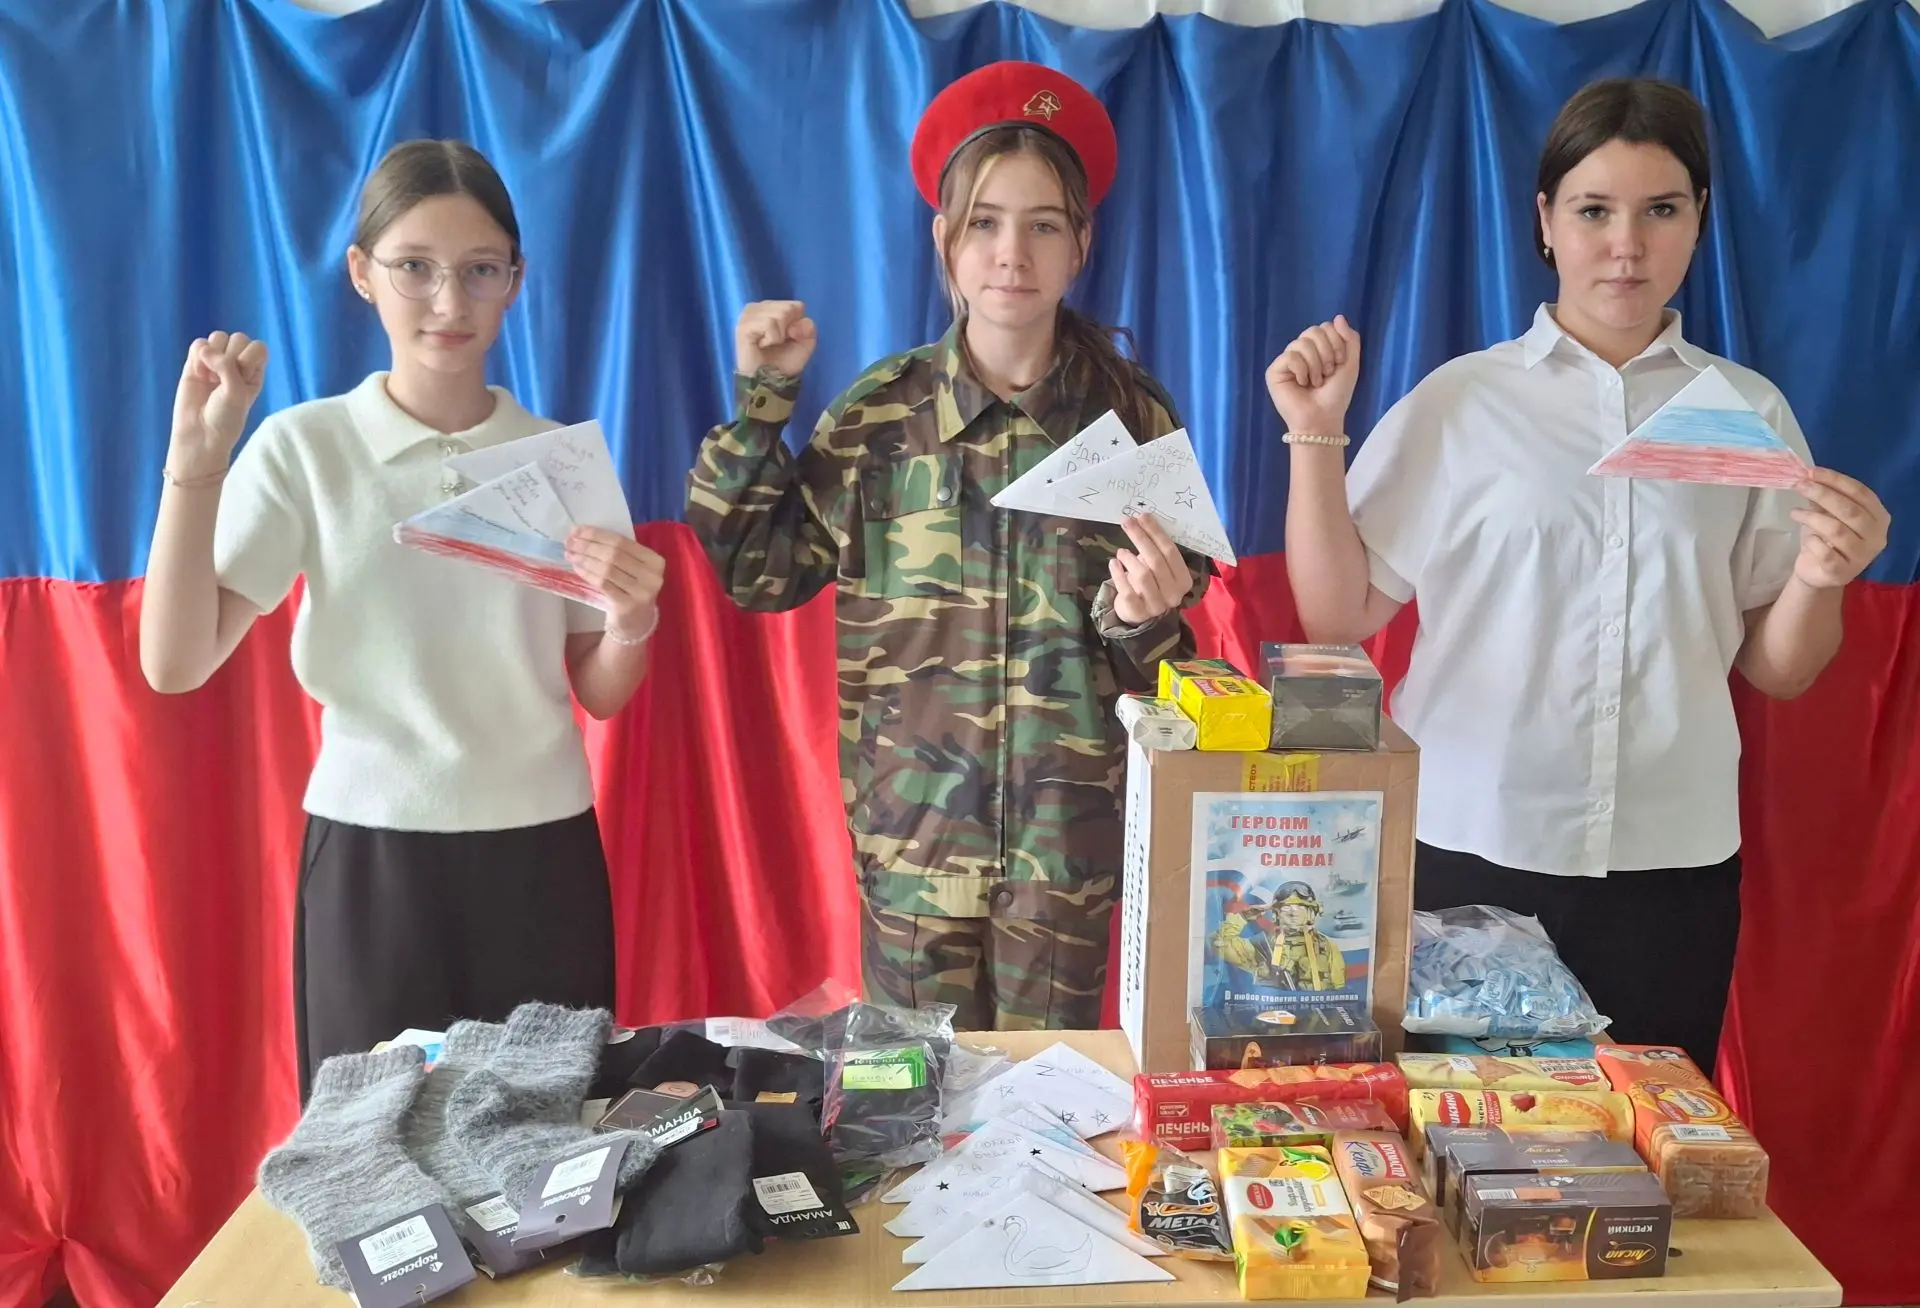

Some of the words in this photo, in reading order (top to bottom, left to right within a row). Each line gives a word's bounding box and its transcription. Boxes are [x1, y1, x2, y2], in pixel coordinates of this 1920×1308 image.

[1231, 815, 1309, 830] ГЕРОЯМ
[1242, 834, 1322, 849] РОССИИ
[1260, 852, 1335, 867] СЛАВА!
[1134, 843, 1146, 992] ПОСЫЛКА
[1150, 1076, 1215, 1086] ПЕЧЕНЬЕ
[1155, 1121, 1211, 1135] ПЕЧЕНЬ
[768, 1209, 834, 1227] АМАНДА
[1606, 1223, 1654, 1234] КРЕПКИЙ
